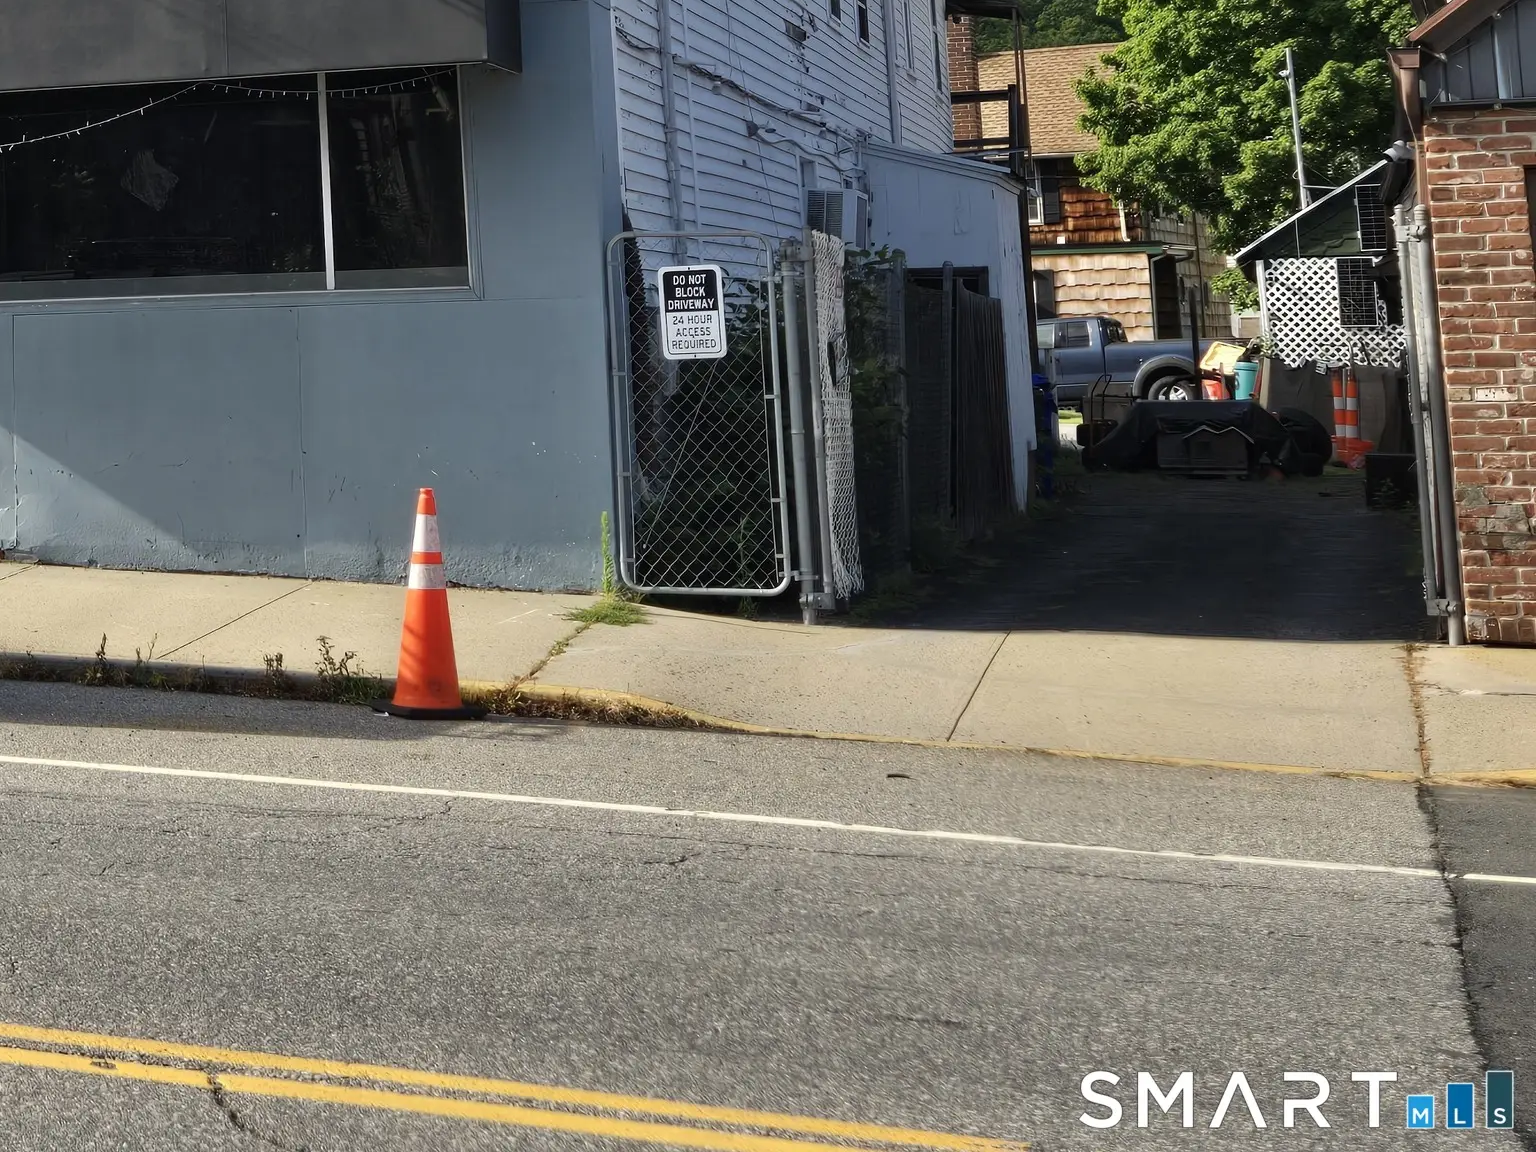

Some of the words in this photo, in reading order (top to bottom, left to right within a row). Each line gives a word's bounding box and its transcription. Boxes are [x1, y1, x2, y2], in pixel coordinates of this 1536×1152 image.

[673, 275, 685, 285] DO
[688, 274, 706, 285] NOT
[675, 286, 706, 297] BLOCK
[668, 298, 714, 310] DRIVEWAY
[672, 315, 684, 325] 24
[687, 314, 713, 324] HOUR
[675, 327, 712, 338] ACCESS
[672, 338, 717, 350] REQUIRED
